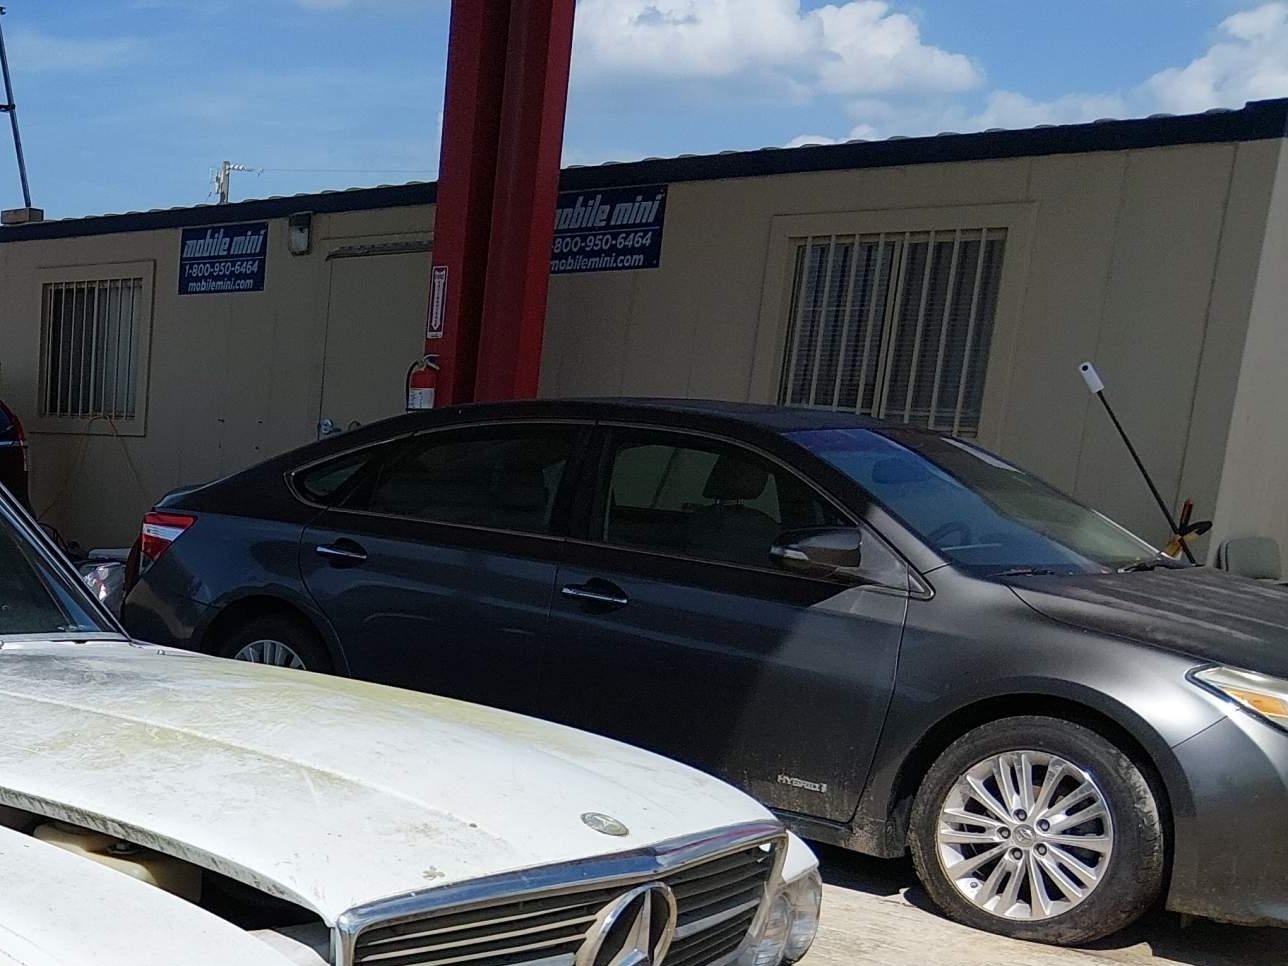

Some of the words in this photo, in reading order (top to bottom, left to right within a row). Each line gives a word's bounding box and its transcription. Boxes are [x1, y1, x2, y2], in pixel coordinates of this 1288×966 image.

[609, 194, 663, 226] mini
[182, 228, 231, 258] mobile
[230, 229, 266, 255] mini
[552, 231, 653, 253] 800-950-6464
[184, 260, 259, 278] 1-800-950-6464
[187, 277, 254, 292] mobilemini.com
